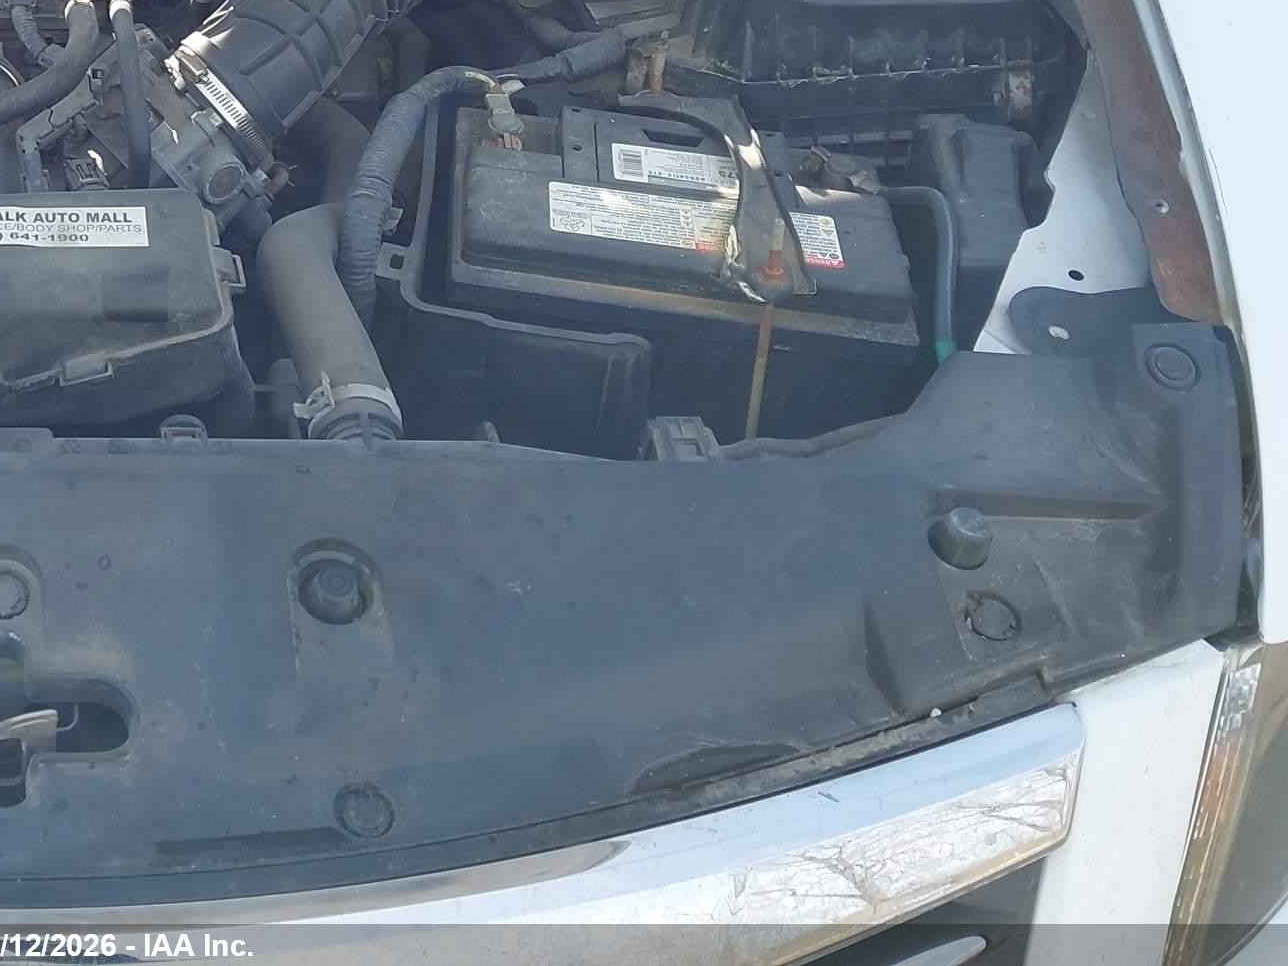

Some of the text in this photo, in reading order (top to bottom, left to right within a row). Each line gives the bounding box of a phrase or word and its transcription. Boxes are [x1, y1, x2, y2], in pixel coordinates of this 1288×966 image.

[33, 212, 81, 224] AUTO
[86, 212, 133, 224] MALL
[58, 223, 142, 234] SHOP/PARTS
[10, 231, 90, 243] 641-1900
